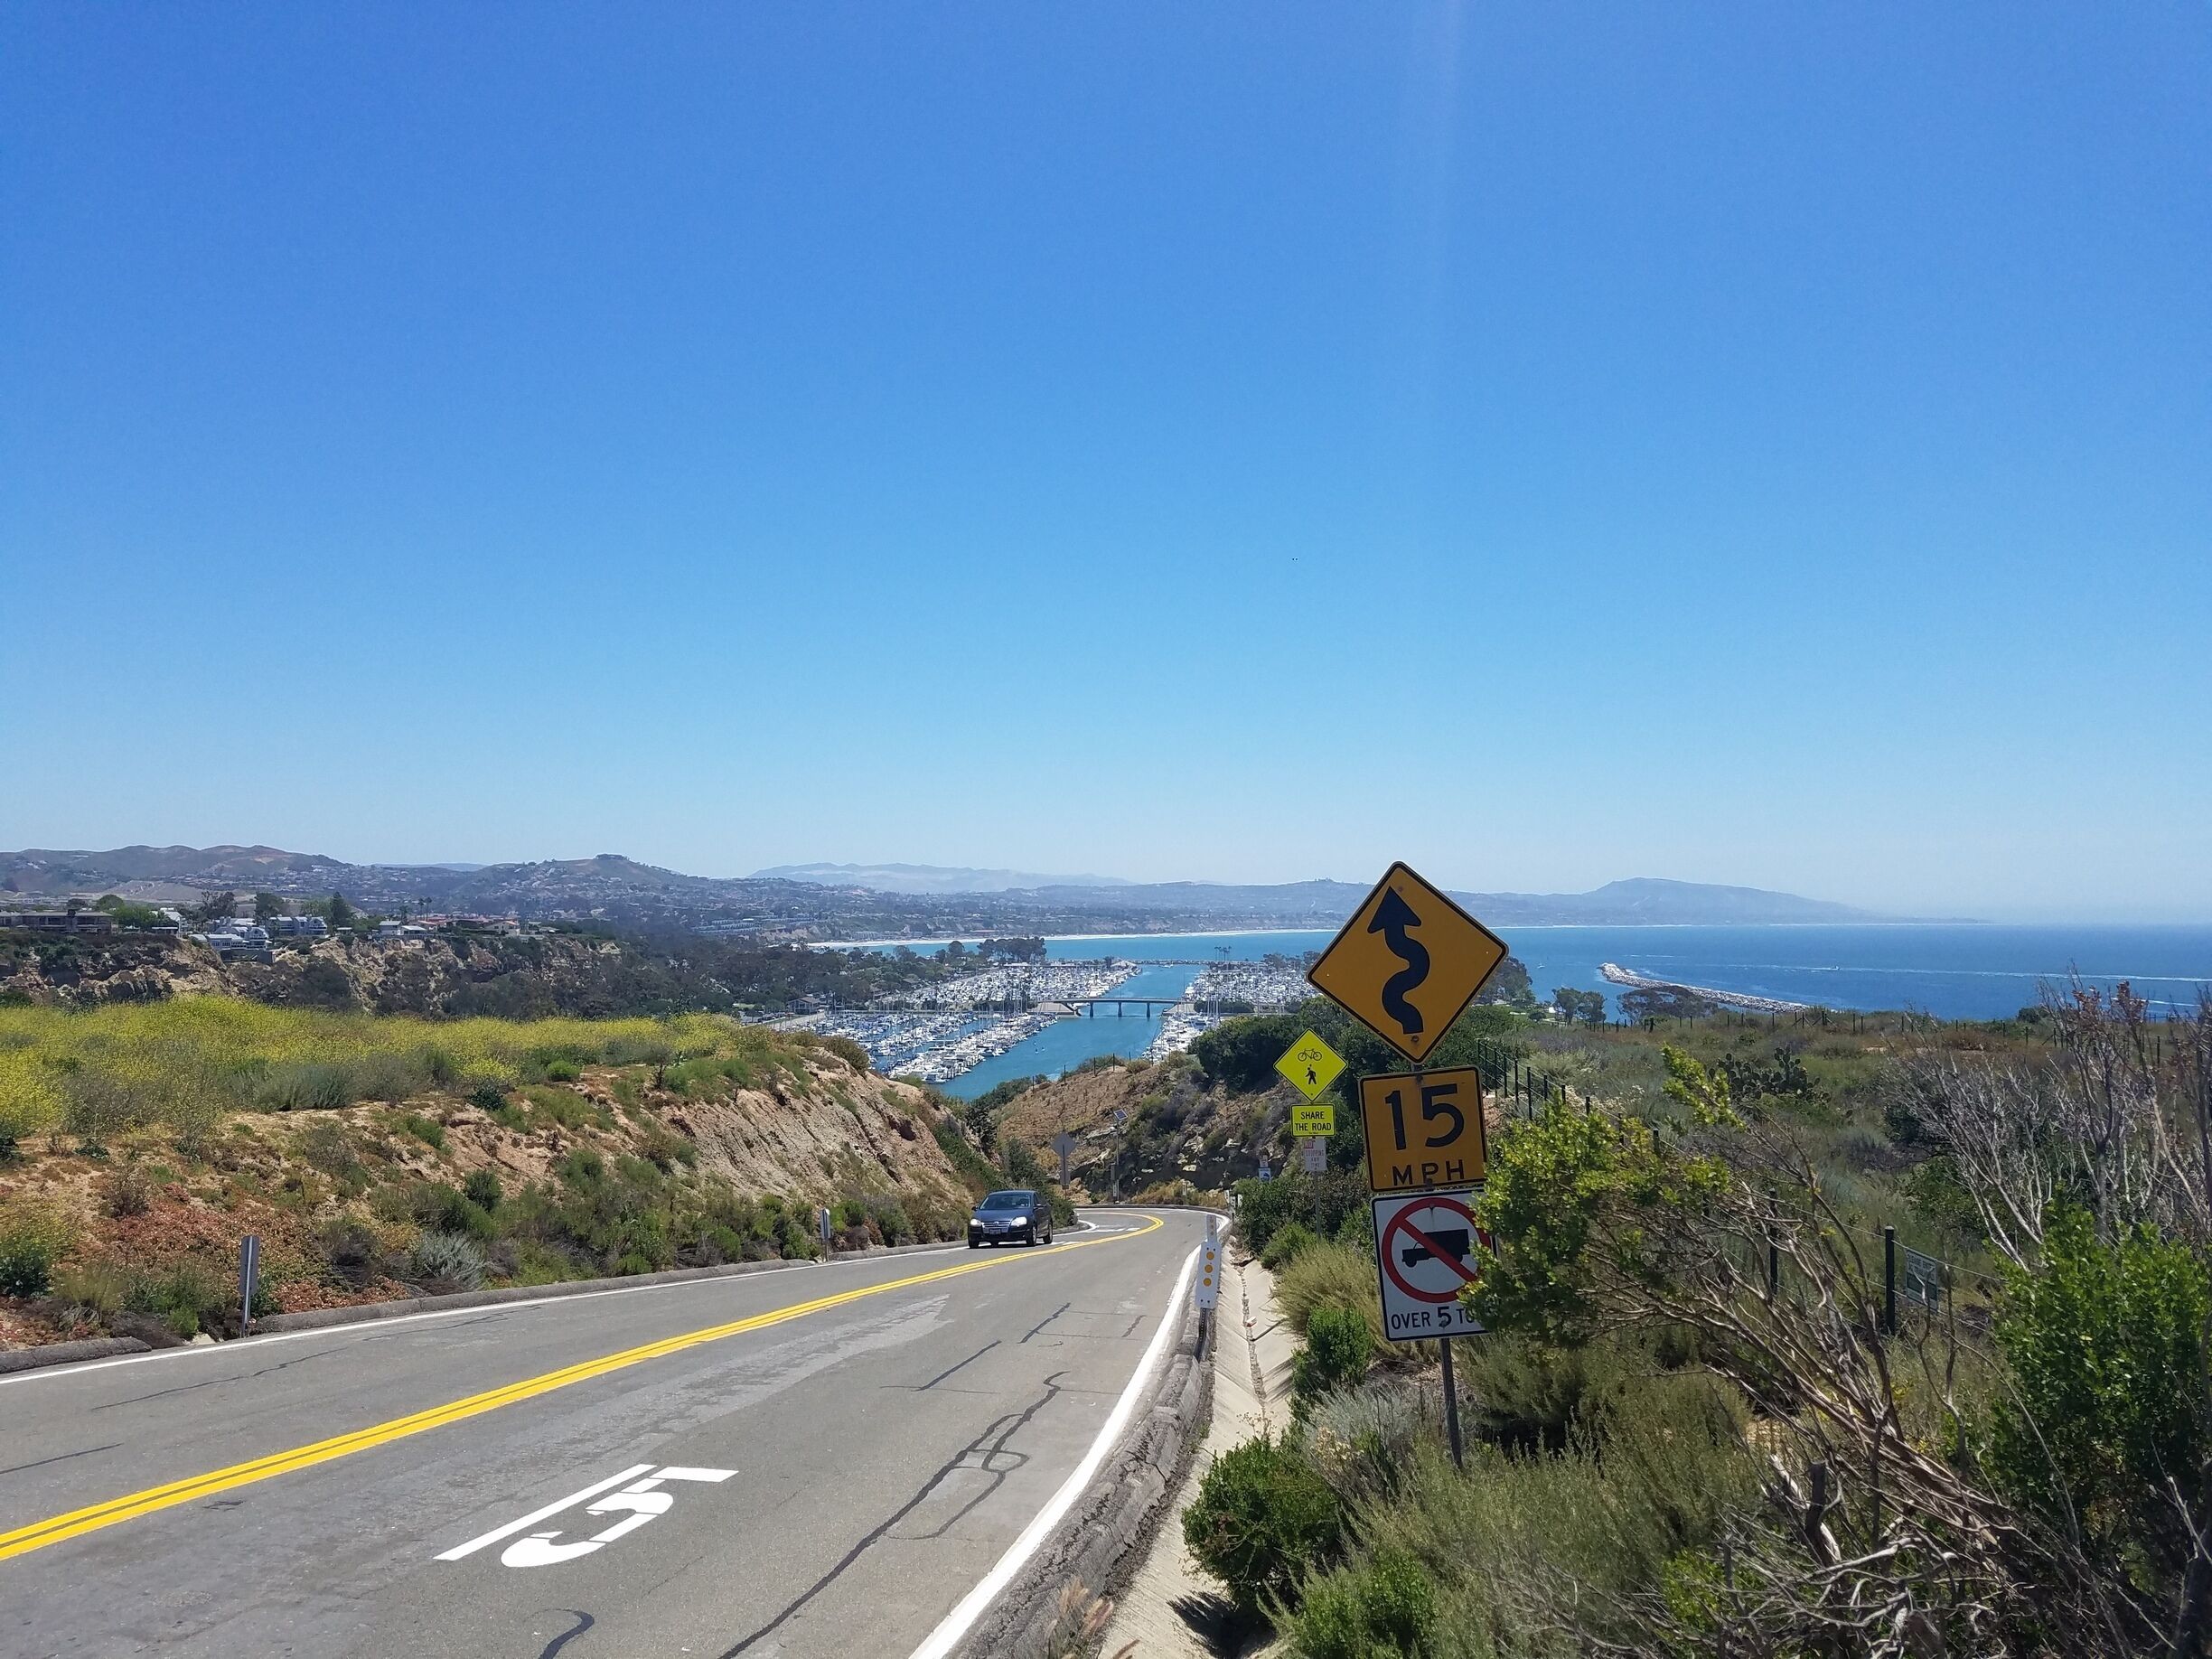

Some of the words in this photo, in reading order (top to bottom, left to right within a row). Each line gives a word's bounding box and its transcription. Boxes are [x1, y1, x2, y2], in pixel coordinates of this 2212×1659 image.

[1295, 1122, 1308, 1131] THE
[1311, 1122, 1331, 1130] ROAD
[1301, 1111, 1325, 1120] SHARE
[1384, 1083, 1465, 1151] 15
[1392, 1158, 1465, 1186] MPH
[1391, 1311, 1431, 1330] OVER
[1437, 1306, 1453, 1327] 5
[432, 1463, 739, 1568] 15
